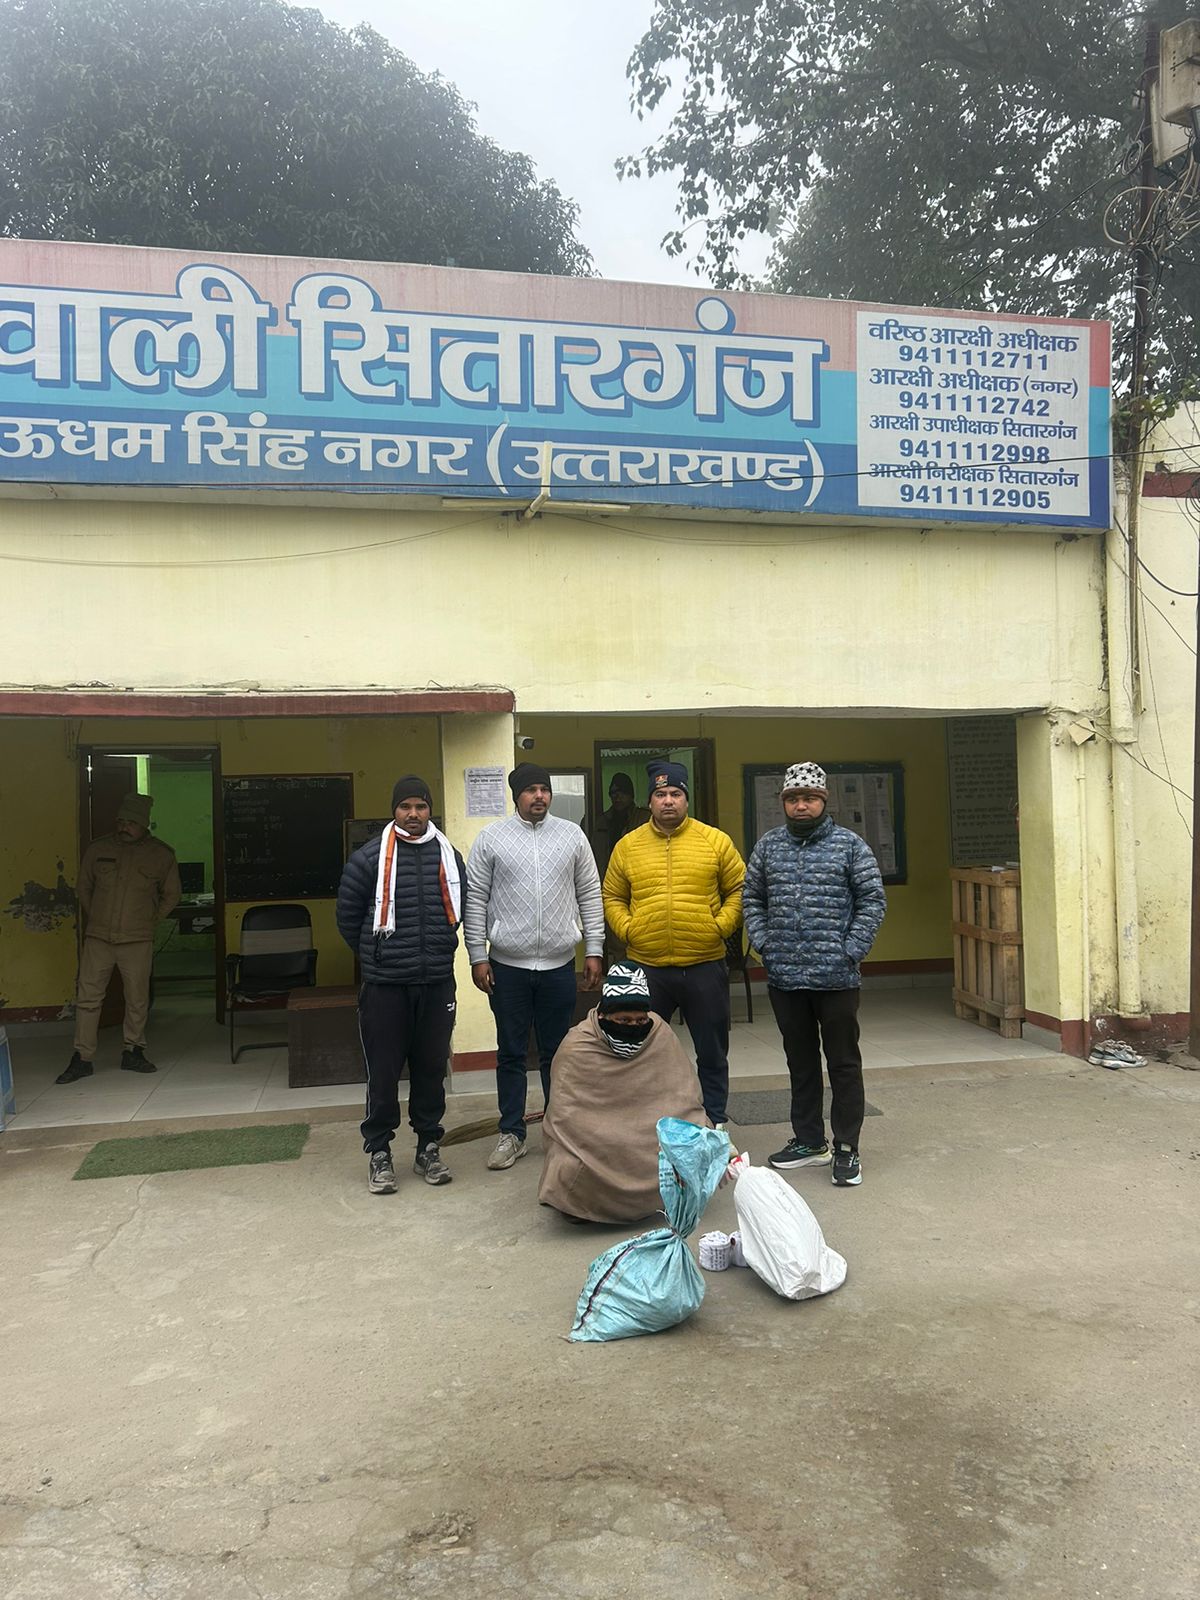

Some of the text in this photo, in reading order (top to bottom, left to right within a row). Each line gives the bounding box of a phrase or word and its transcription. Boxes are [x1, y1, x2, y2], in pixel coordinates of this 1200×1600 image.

[287, 273, 825, 422] सितारगंज
[868, 318, 1080, 352] वरिष्ठ आरक्षी अधीक्षक
[898, 345, 1048, 371] 9411112711
[869, 365, 1079, 399] आरक्षी अधीक्षक (नगर)
[899, 391, 1050, 417] 9411112742
[869, 412, 1078, 440] आरक्षी उपाधीक्षक सितारगंज
[0, 411, 825, 508] ऊधम सिंह नगर (उत्तराखण्ड)
[899, 438, 1050, 464] 9411112998
[869, 460, 1080, 488] आरक्षी निरीक्षक सितारगंज
[900, 484, 1051, 509] 9411112905
